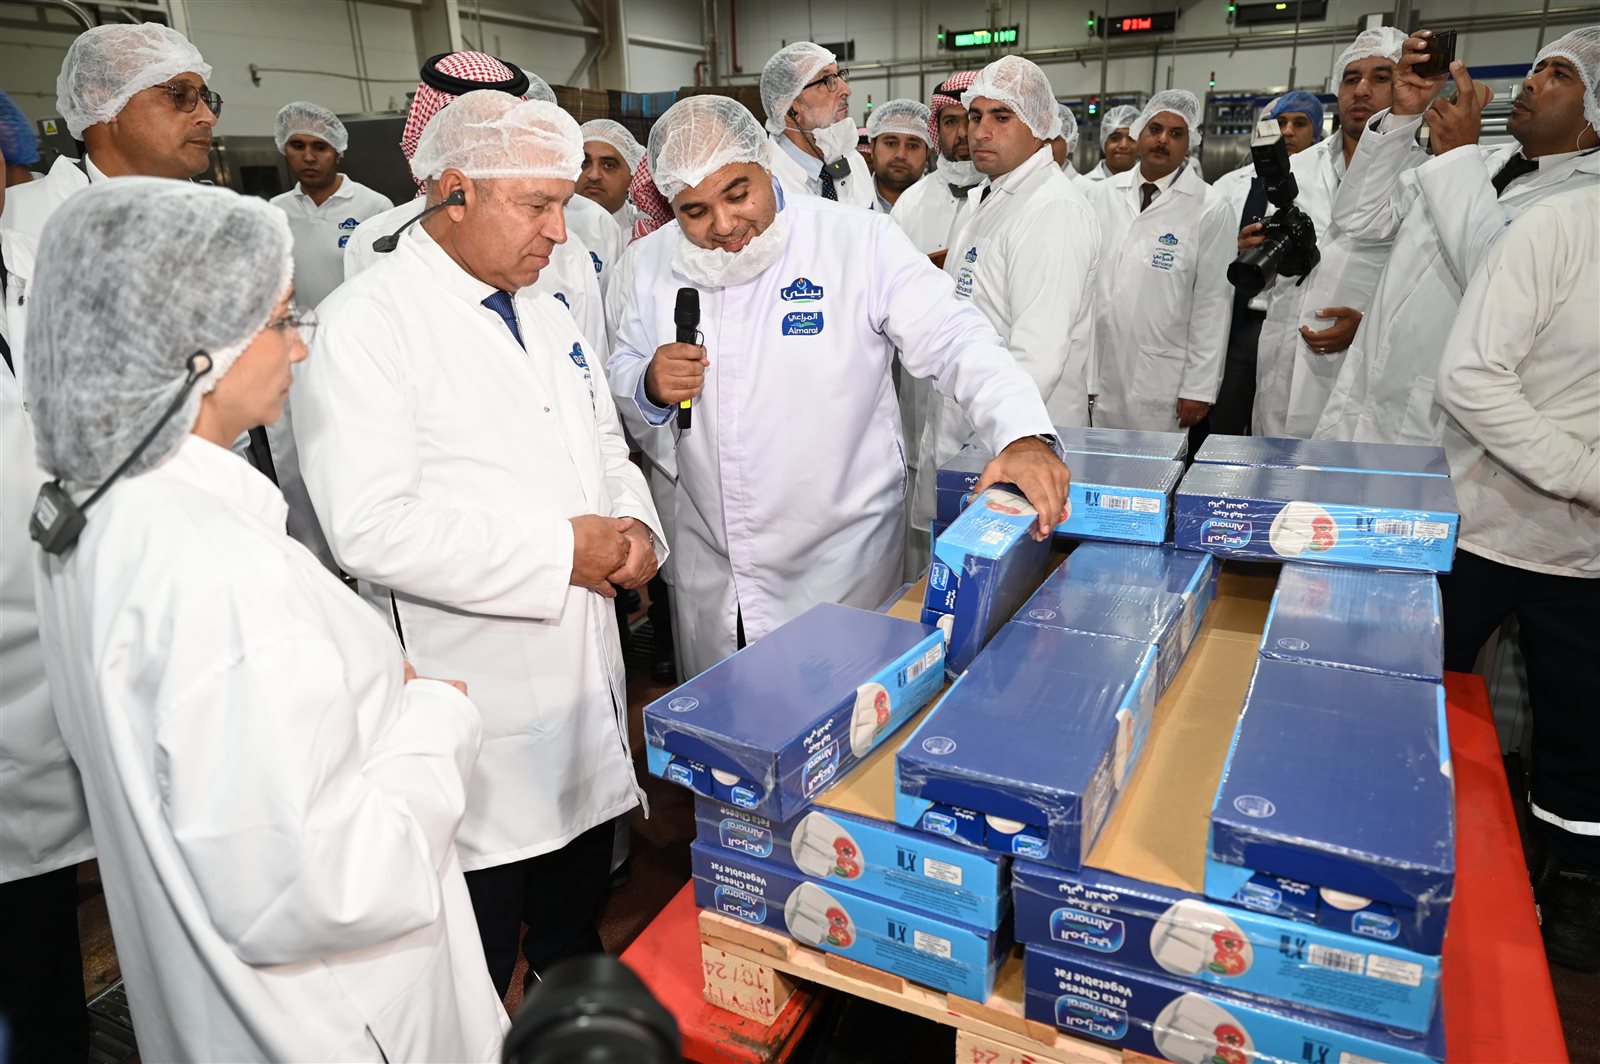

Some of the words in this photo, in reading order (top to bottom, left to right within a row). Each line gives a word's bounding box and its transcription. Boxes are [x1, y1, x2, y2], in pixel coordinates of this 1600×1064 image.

[787, 312, 818, 322] المراعي
[787, 326, 819, 335] Almarai
[1208, 521, 1244, 530] Almarai
[1208, 534, 1242, 544] المراعي
[720, 807, 750, 822] Cheese
[752, 816, 770, 827] Feta
[726, 821, 764, 838] Almarai
[728, 838, 764, 854] المراعي
[710, 861, 724, 872] Fat
[715, 873, 744, 889] Cheese
[724, 865, 767, 886] Vegetable
[721, 888, 758, 905] Almarai
[746, 883, 764, 895] Feta
[723, 903, 759, 920] المراعي
[1060, 911, 1113, 931] Almarai
[1061, 930, 1112, 949] المراعي
[1054, 967, 1072, 980] Fat
[1058, 981, 1100, 1001] Cheese
[1073, 971, 1133, 998] Vegetable
[1065, 998, 1117, 1019] Almarai
[1102, 993, 1127, 1008] Feta
[1066, 1015, 1116, 1036] المراعي
